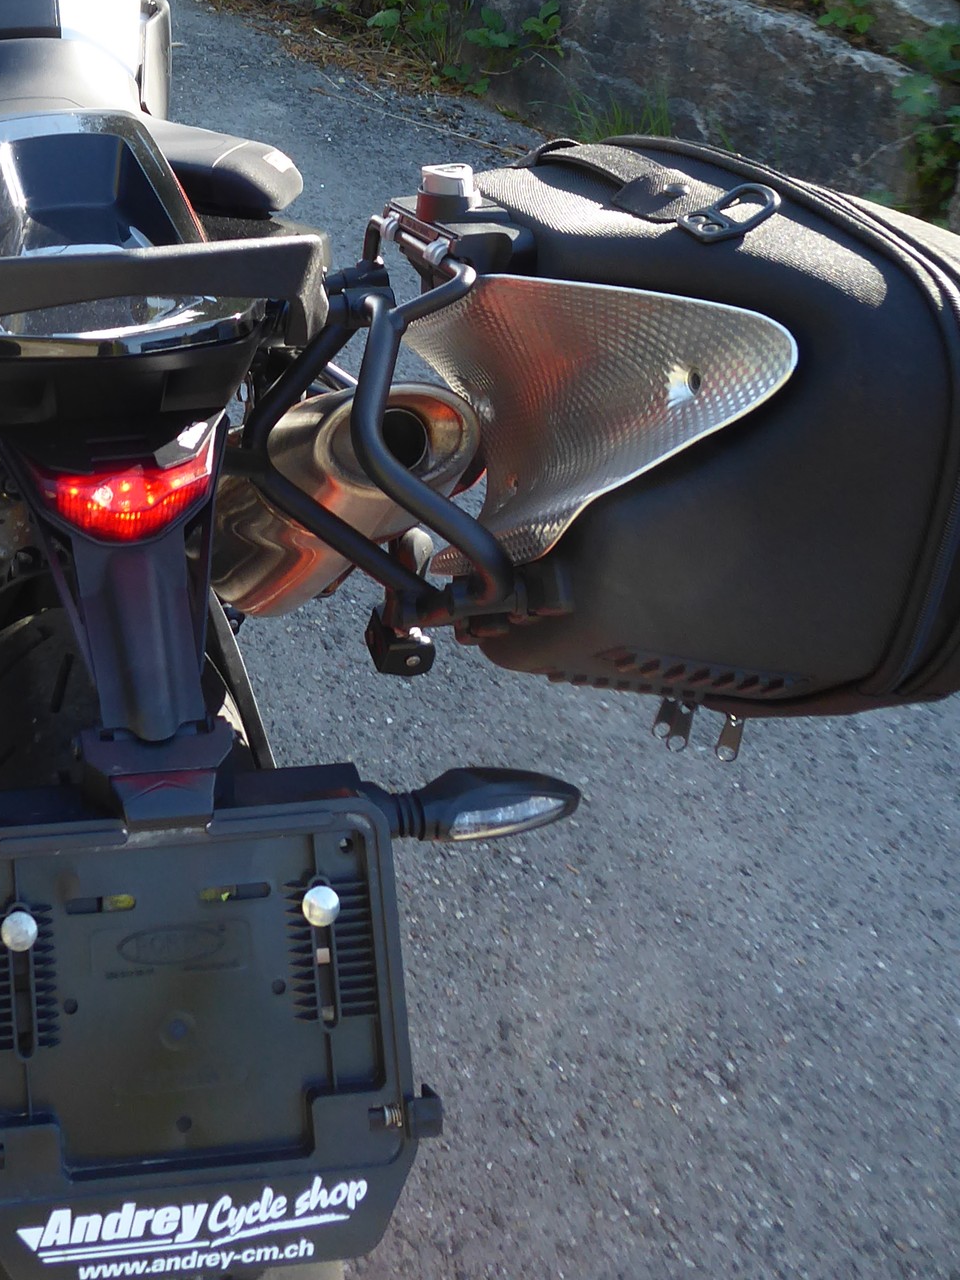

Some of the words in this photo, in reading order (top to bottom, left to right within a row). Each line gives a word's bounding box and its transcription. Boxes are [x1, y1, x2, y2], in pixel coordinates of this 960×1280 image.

[40, 1202, 209, 1244] Andrey
[208, 1186, 287, 1236] Cycle
[295, 1175, 368, 1217] shop
[79, 1238, 314, 1280] www.andrey-cm.ch
